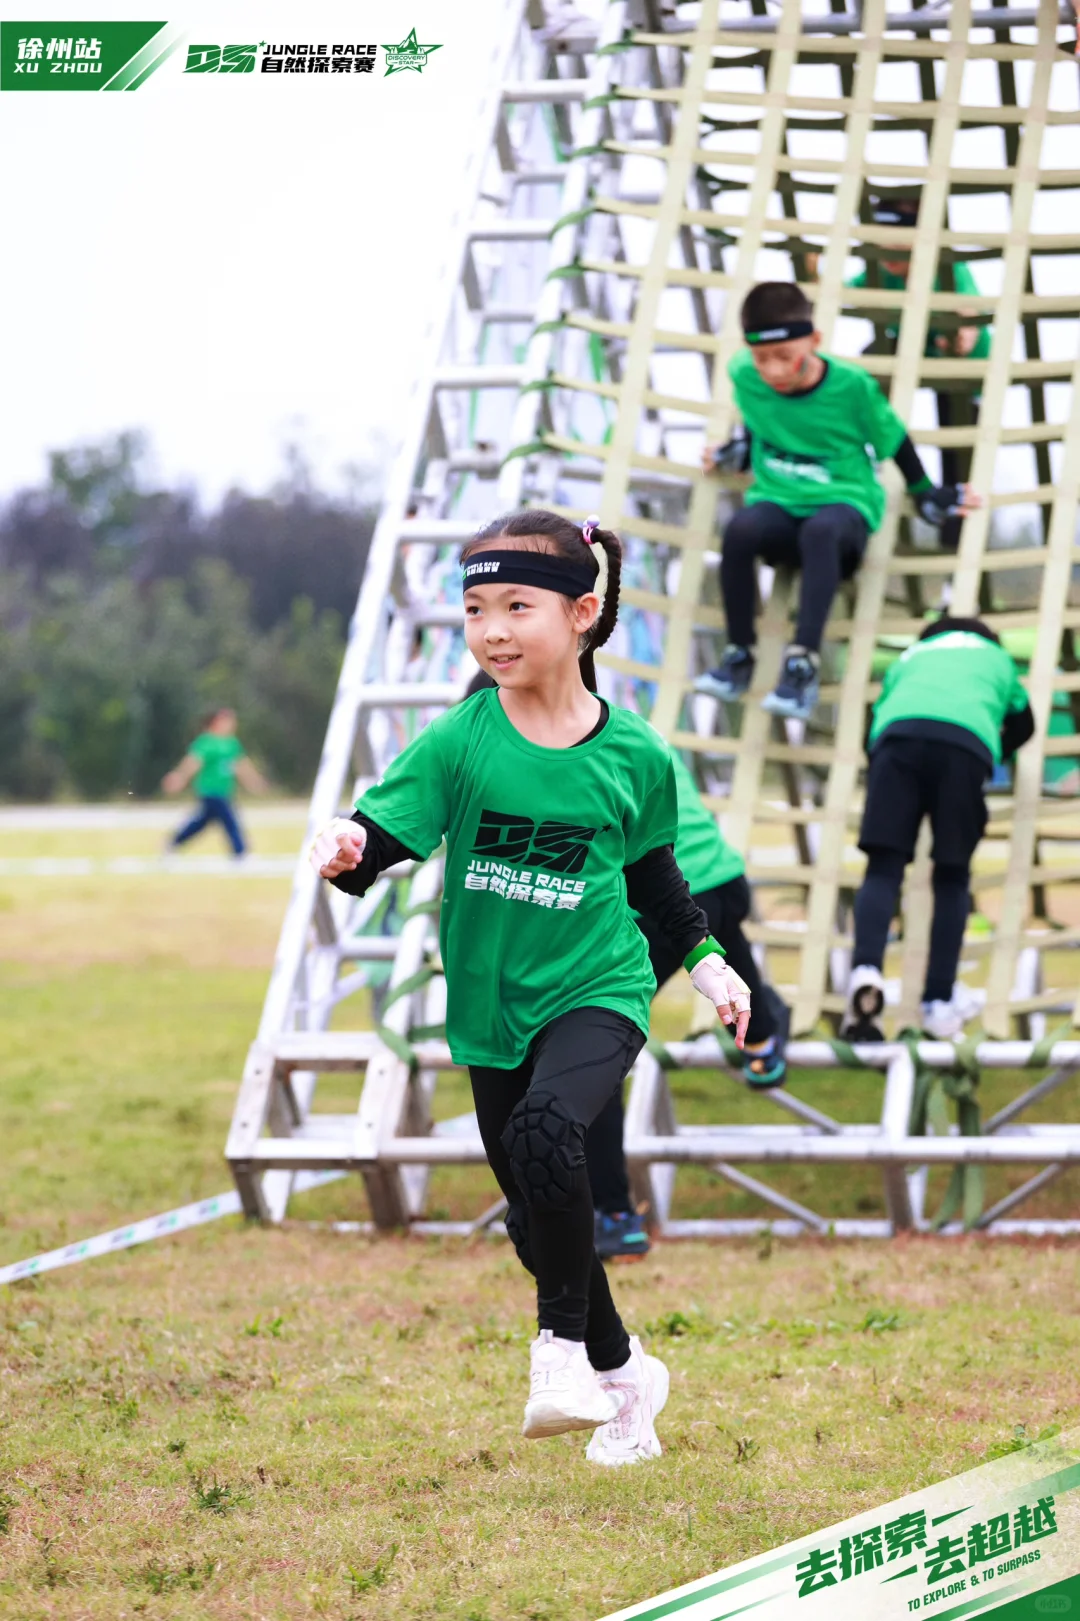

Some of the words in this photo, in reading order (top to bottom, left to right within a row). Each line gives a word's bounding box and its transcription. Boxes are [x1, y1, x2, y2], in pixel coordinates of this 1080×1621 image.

[468, 808, 598, 874] DS
[464, 872, 584, 911] 自然探索赛
[467, 860, 533, 884] JUNGLE
[535, 873, 587, 893] RACE
